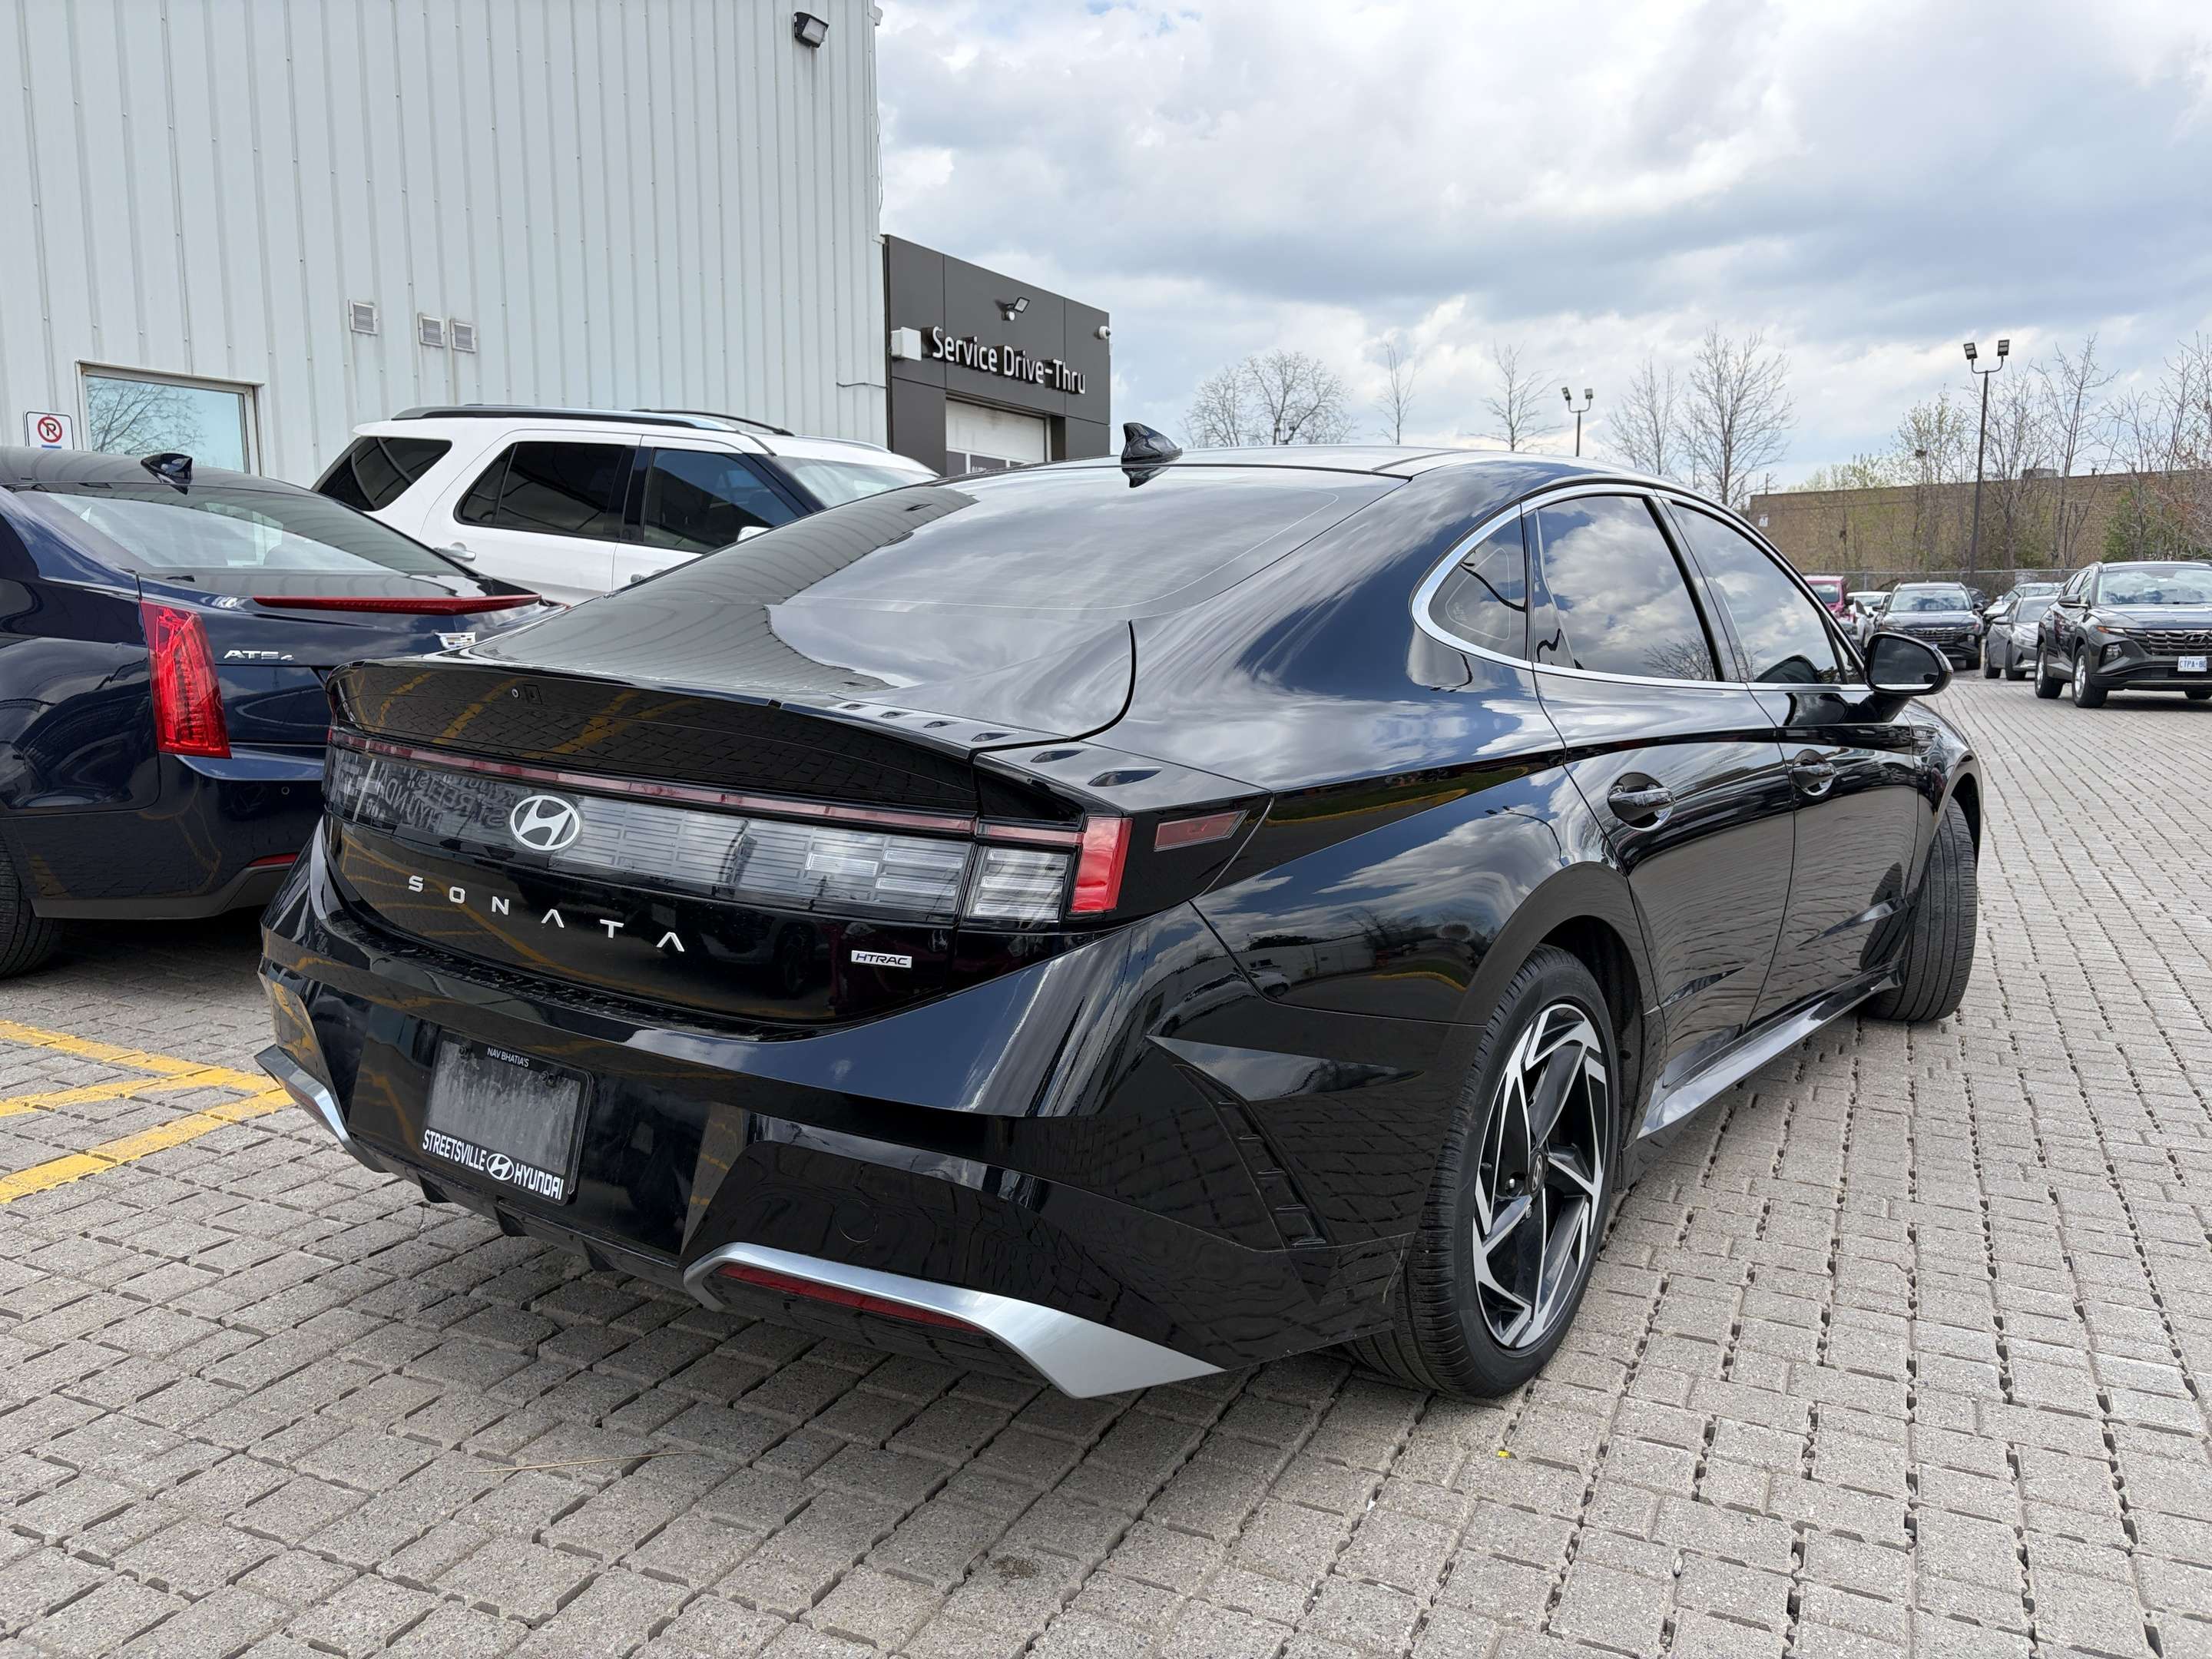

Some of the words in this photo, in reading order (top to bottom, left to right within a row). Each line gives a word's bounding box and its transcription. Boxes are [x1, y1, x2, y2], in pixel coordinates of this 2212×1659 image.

[932, 326, 998, 373] Service
[1003, 345, 1086, 394] Drive-Thru
[408, 875, 685, 952] SONATA
[856, 953, 908, 965] HTRAC
[487, 1047, 501, 1058] NAV
[501, 1051, 529, 1068] BHATIA'S
[422, 1130, 487, 1171] STREETSVILLE
[513, 1163, 565, 1200] HYUNDAI
